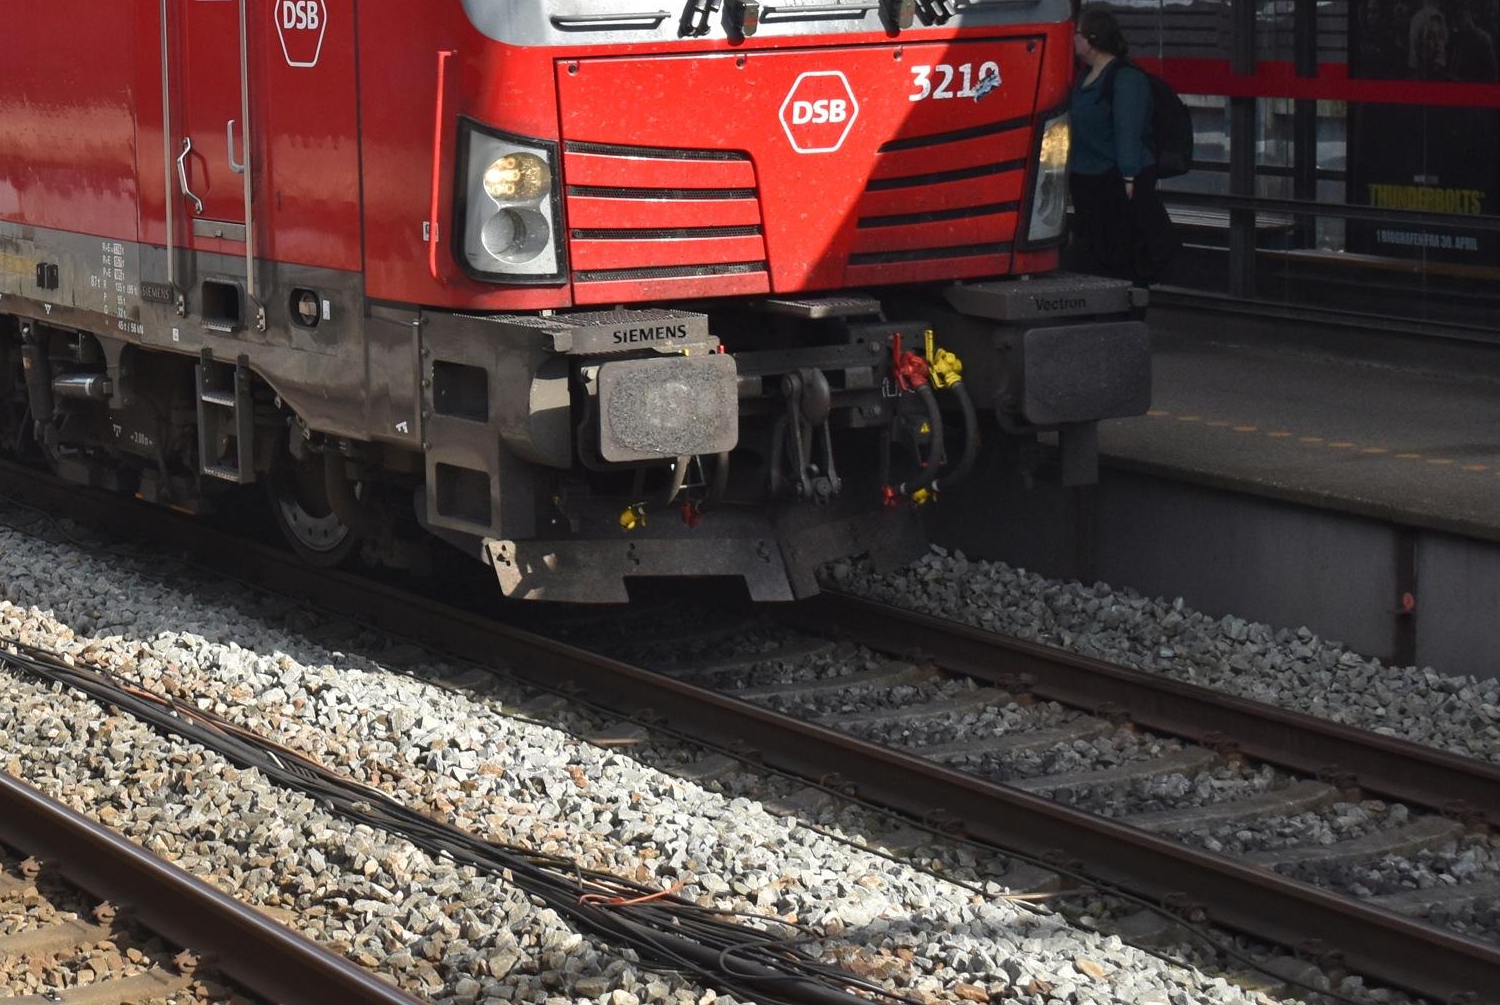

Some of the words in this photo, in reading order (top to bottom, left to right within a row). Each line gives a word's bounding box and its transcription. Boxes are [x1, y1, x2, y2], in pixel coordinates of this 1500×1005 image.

[282, 0, 319, 31] DSB
[792, 99, 847, 126] DSB
[141, 286, 170, 300] SIEMENS
[1035, 297, 1087, 312] Vectron
[612, 324, 689, 344] SIEMENS
